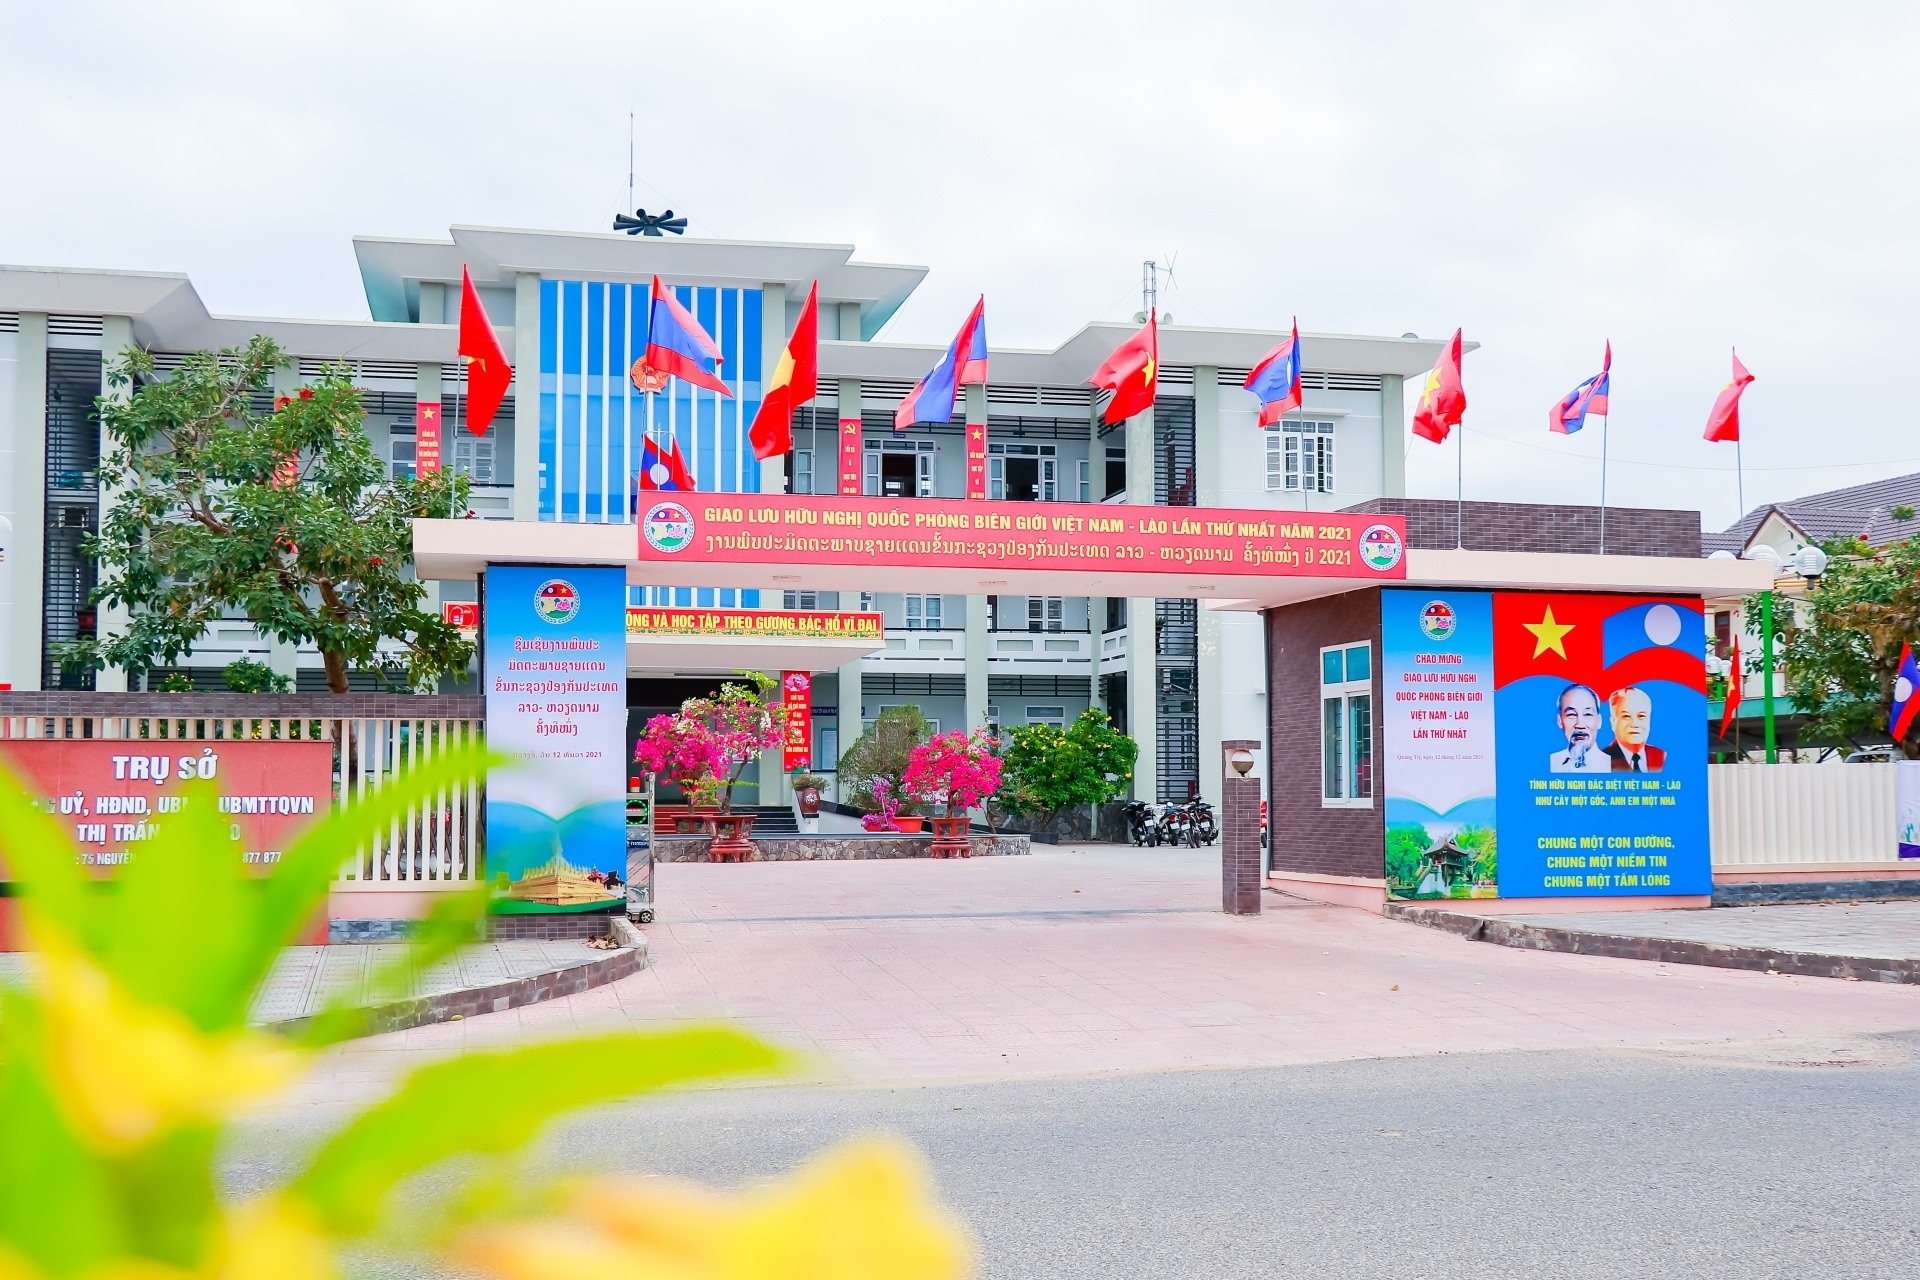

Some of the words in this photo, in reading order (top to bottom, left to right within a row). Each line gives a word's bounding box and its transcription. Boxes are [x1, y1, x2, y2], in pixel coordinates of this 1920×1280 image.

[704, 507, 743, 523] GIAO
[748, 508, 780, 524] LƯU
[784, 508, 818, 524] HỮU
[822, 510, 862, 528] NGHỊ
[867, 507, 910, 528] QUỐC
[915, 510, 969, 529] PHÒNG
[974, 513, 1011, 530] BIÊN
[1015, 513, 1047, 531] GIỚI
[1051, 514, 1084, 535] VIỆT
[1088, 518, 1124, 533] NAM
[1139, 517, 1168, 534] LÀO
[1172, 516, 1201, 535] LẦN
[1205, 520, 1235, 536] THỨ
[1237, 520, 1276, 538] NHẤT
[1280, 522, 1315, 539] NĂM
[1318, 526, 1352, 541] 2021
[1318, 549, 1351, 565] 2021
[652, 612, 669, 627] VÀ
[671, 615, 696, 629] HỌC
[698, 613, 721, 629] TẬP
[724, 615, 753, 629] THEO
[756, 615, 796, 630] GƯƠNG
[798, 614, 822, 631] BÁC
[825, 614, 841, 630] HỒ
[843, 615, 855, 631] VĨ
[857, 618, 877, 632] ĐẠI
[1416, 653, 1436, 664] CHÀO
[1404, 673, 1422, 682] GIAO
[1424, 673, 1438, 682] LƯU
[1440, 672, 1456, 682] HỮU
[1458, 674, 1476, 684] NGHỊ
[1396, 688, 1416, 702] QUỐC
[1418, 690, 1445, 702] PHÒNG
[1448, 690, 1465, 702] BIÊN
[1468, 690, 1483, 702] GIỚI
[1410, 709, 1427, 722] VIỆT
[1429, 710, 1446, 720] NAM
[1430, 728, 1446, 738] THỨ
[1447, 727, 1468, 738] NHẤT
[112, 755, 170, 785] TRỤ
[178, 747, 219, 781] SỞ
[1528, 778, 1548, 790] TÌNH
[1549, 778, 1565, 790] HỮU
[1567, 780, 1586, 792] NGHỊ
[1588, 778, 1604, 792] ĐẶC
[1606, 778, 1622, 792] BIỆT
[1624, 778, 1640, 792] VIỆT
[1642, 780, 1660, 790] NAM
[60, 790, 90, 817] UỶ,
[96, 796, 152, 816] HĐND,
[218, 795, 314, 816] UBMTTQVN
[1536, 795, 1553, 806] NHƯ
[1554, 794, 1569, 806] CÂY
[1571, 794, 1588, 808] MỘT
[1610, 796, 1626, 806] ANH
[1628, 796, 1640, 806] EM
[1642, 794, 1658, 808] MỘT
[77, 823, 107, 846] THỊ
[1538, 837, 1577, 849] CHUNG
[1580, 834, 1604, 851] MỘT
[1607, 836, 1631, 849] CON
[1634, 834, 1676, 849] ĐƯỜNG,
[82, 853, 95, 865] 75
[263, 852, 282, 863] 877
[1547, 856, 1586, 868] CHUNG
[1589, 854, 1614, 870] MỘT
[1648, 856, 1667, 867] TIN
[1544, 876, 1583, 888] CHUNG
[1586, 873, 1611, 890] MỘT
[1614, 870, 1638, 887] TẤM
[1641, 872, 1671, 886] LÒNG
